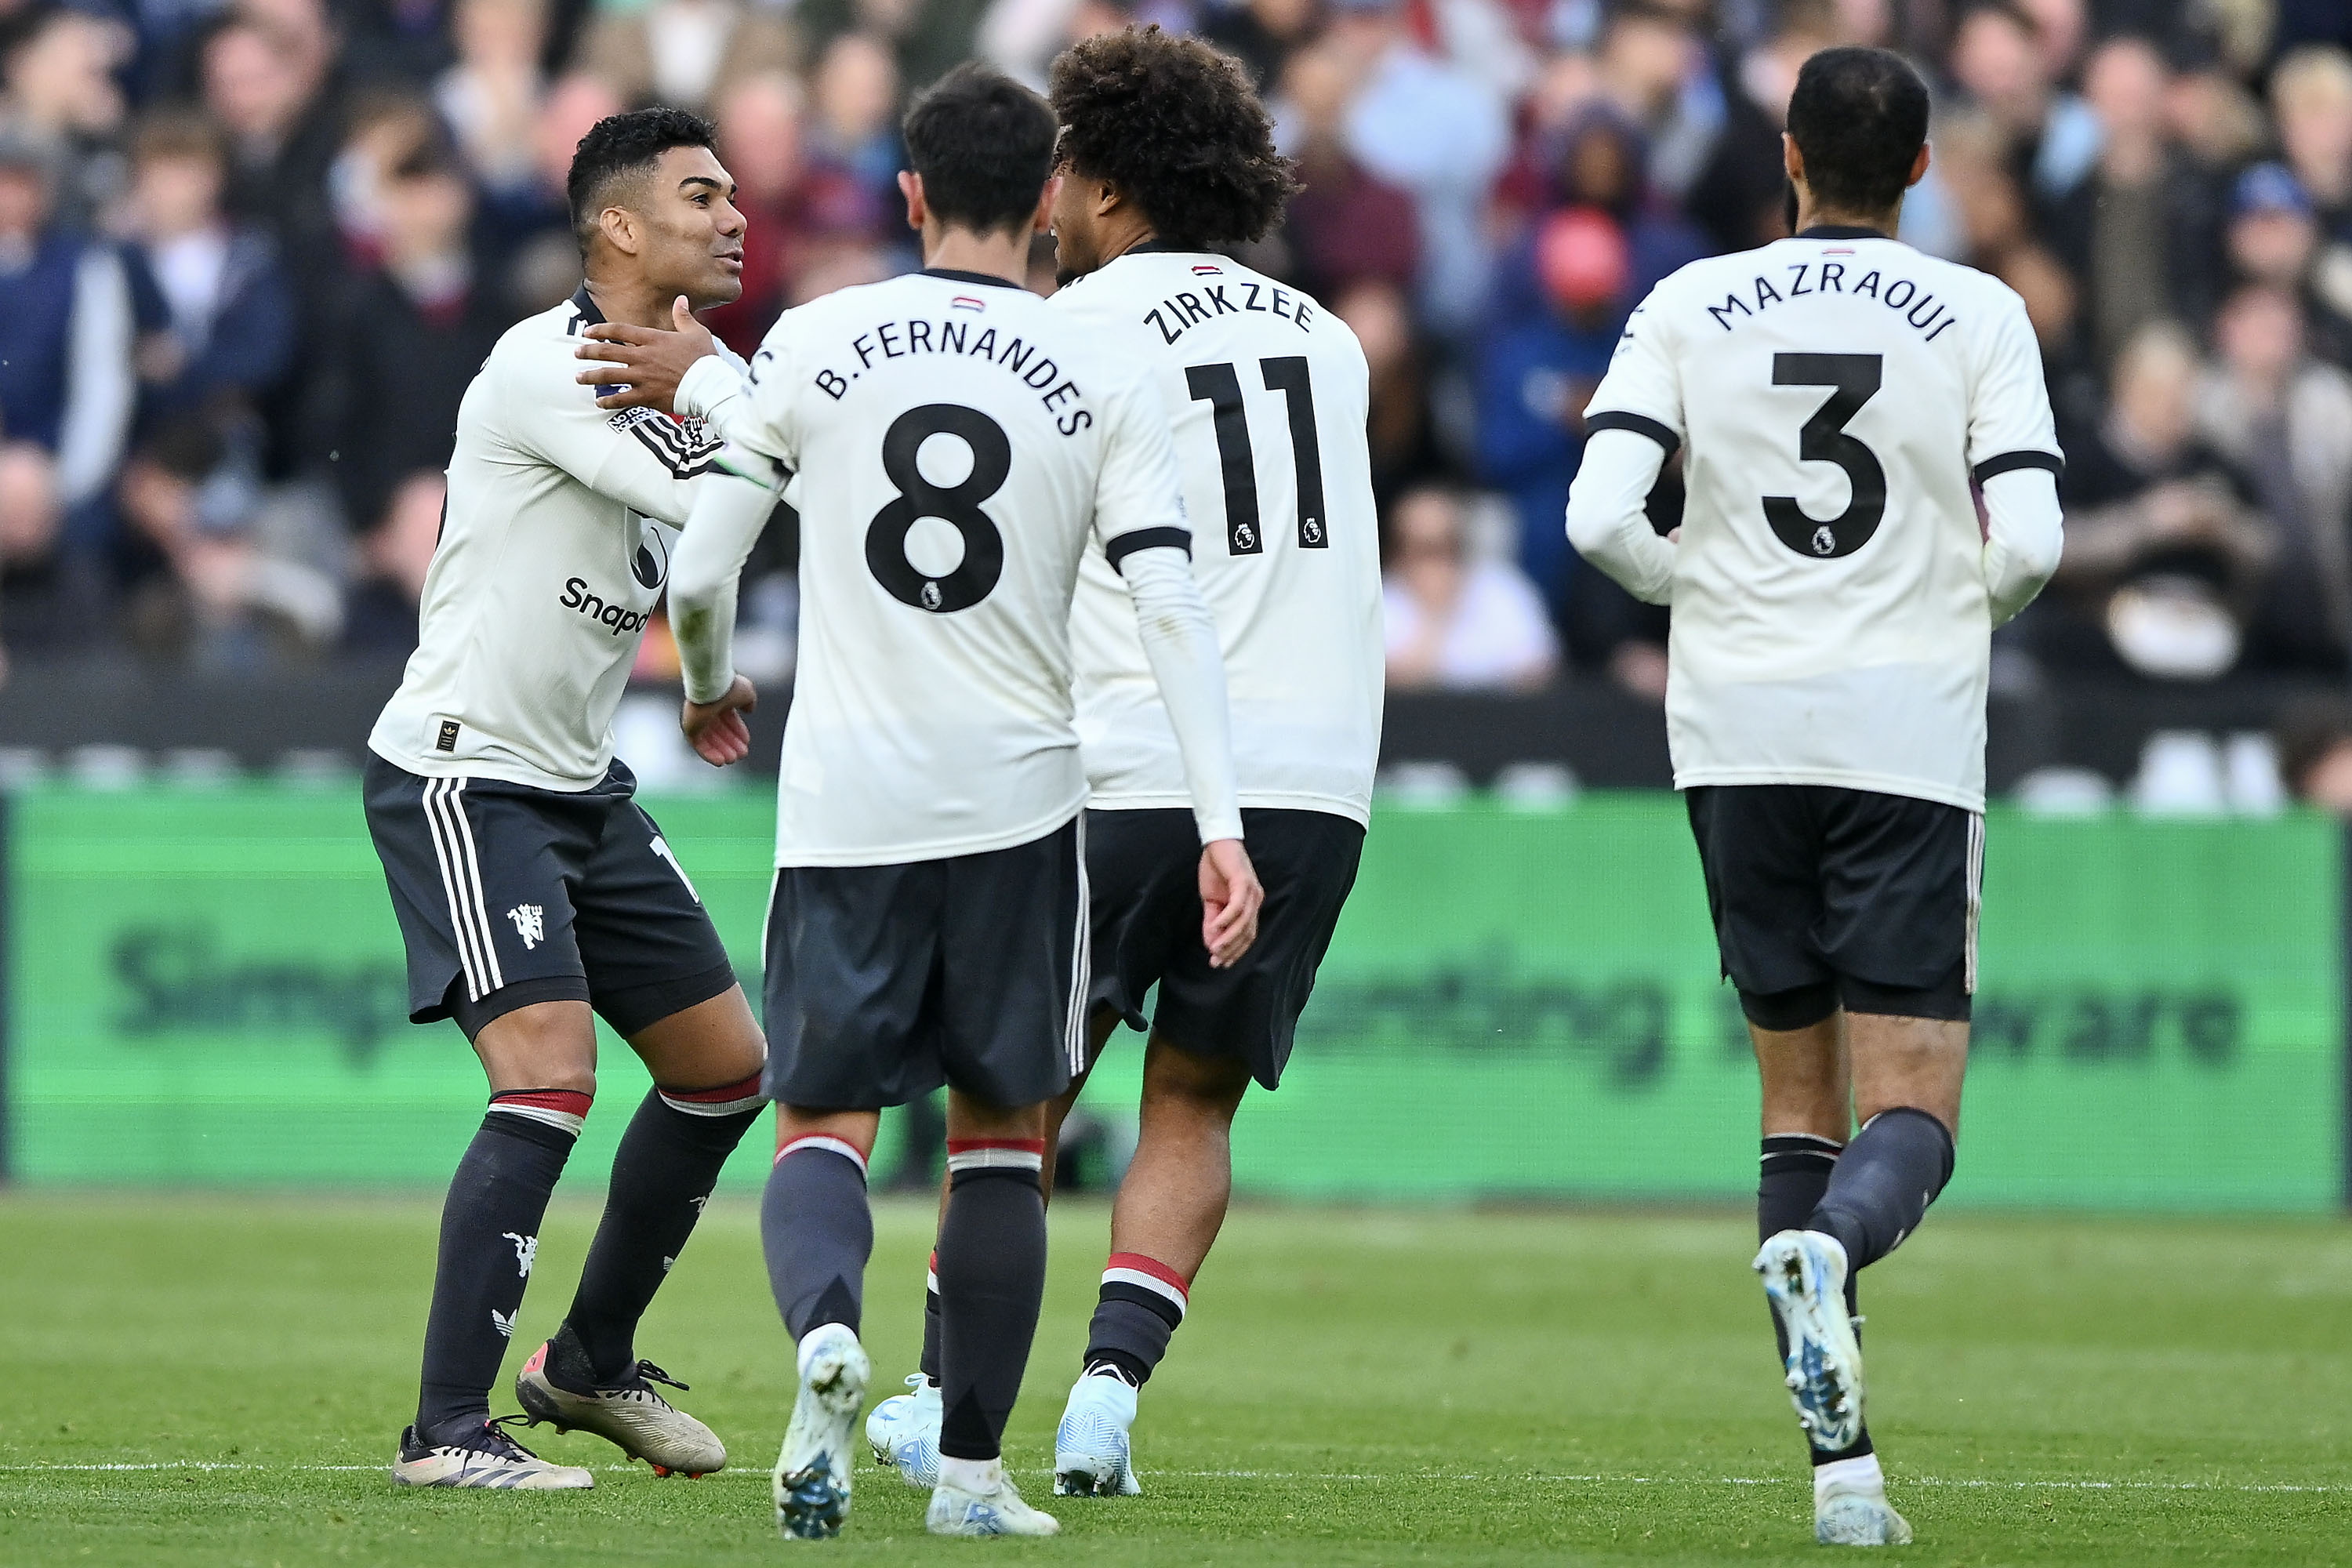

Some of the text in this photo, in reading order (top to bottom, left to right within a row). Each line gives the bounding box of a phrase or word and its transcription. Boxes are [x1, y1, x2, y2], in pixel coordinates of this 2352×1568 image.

[1143, 283, 1313, 345] ZIRKZEE
[1708, 263, 1955, 342] MAZRAOUI
[609, 406, 650, 428] No roo
[815, 321, 1093, 437] B.FERNANDES
[1185, 357, 1329, 556] 11
[1762, 353, 1887, 559] 3
[866, 403, 1011, 613] 8
[559, 577, 653, 636] Snapd
